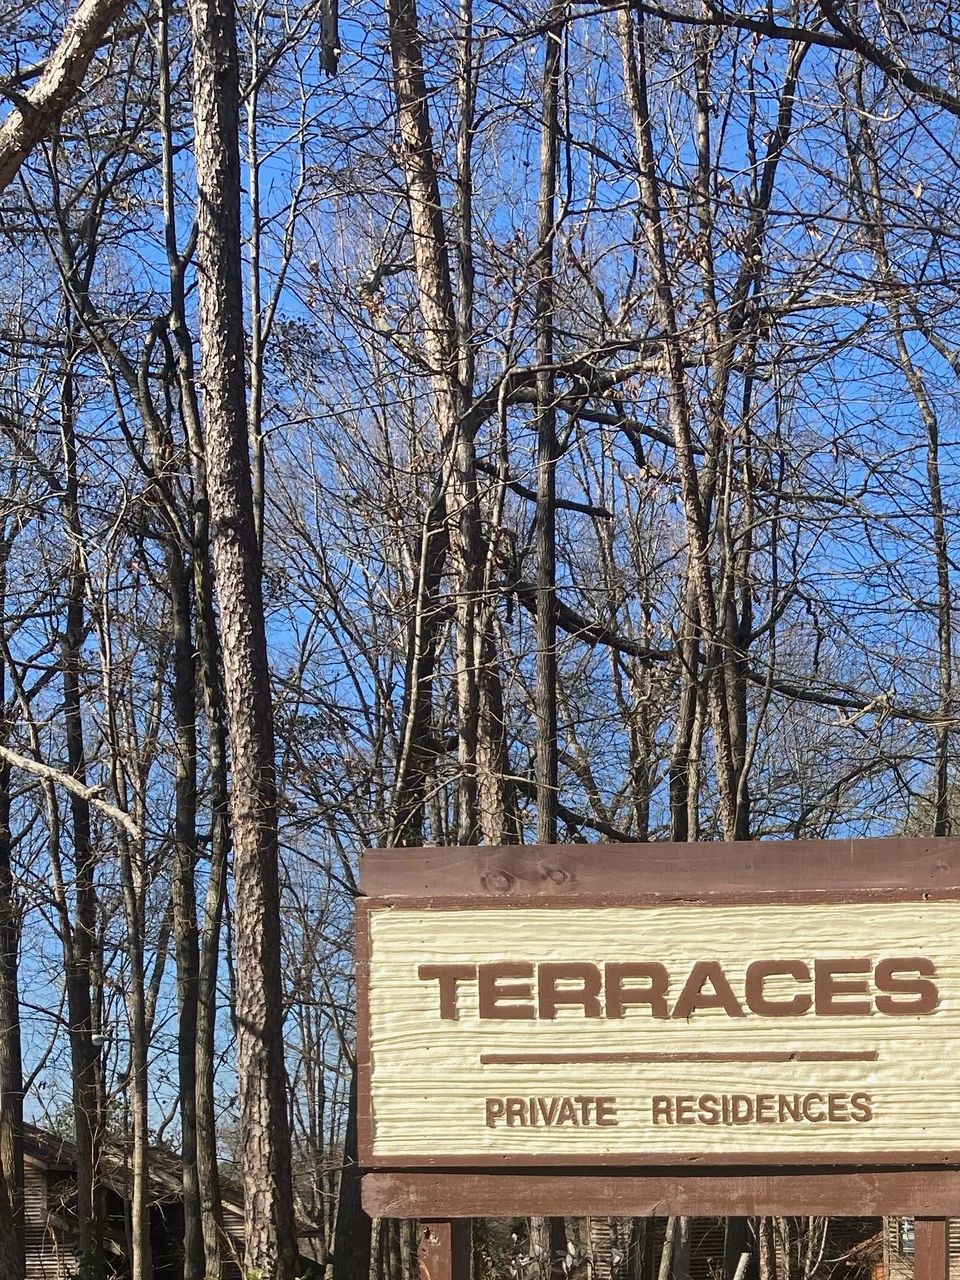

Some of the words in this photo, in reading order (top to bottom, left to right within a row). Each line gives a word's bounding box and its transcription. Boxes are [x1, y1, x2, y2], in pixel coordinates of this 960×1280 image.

[418, 957, 940, 1021] TERRACES
[485, 1096, 618, 1128] PRIVATE
[652, 1092, 873, 1126] RESIDENCES
